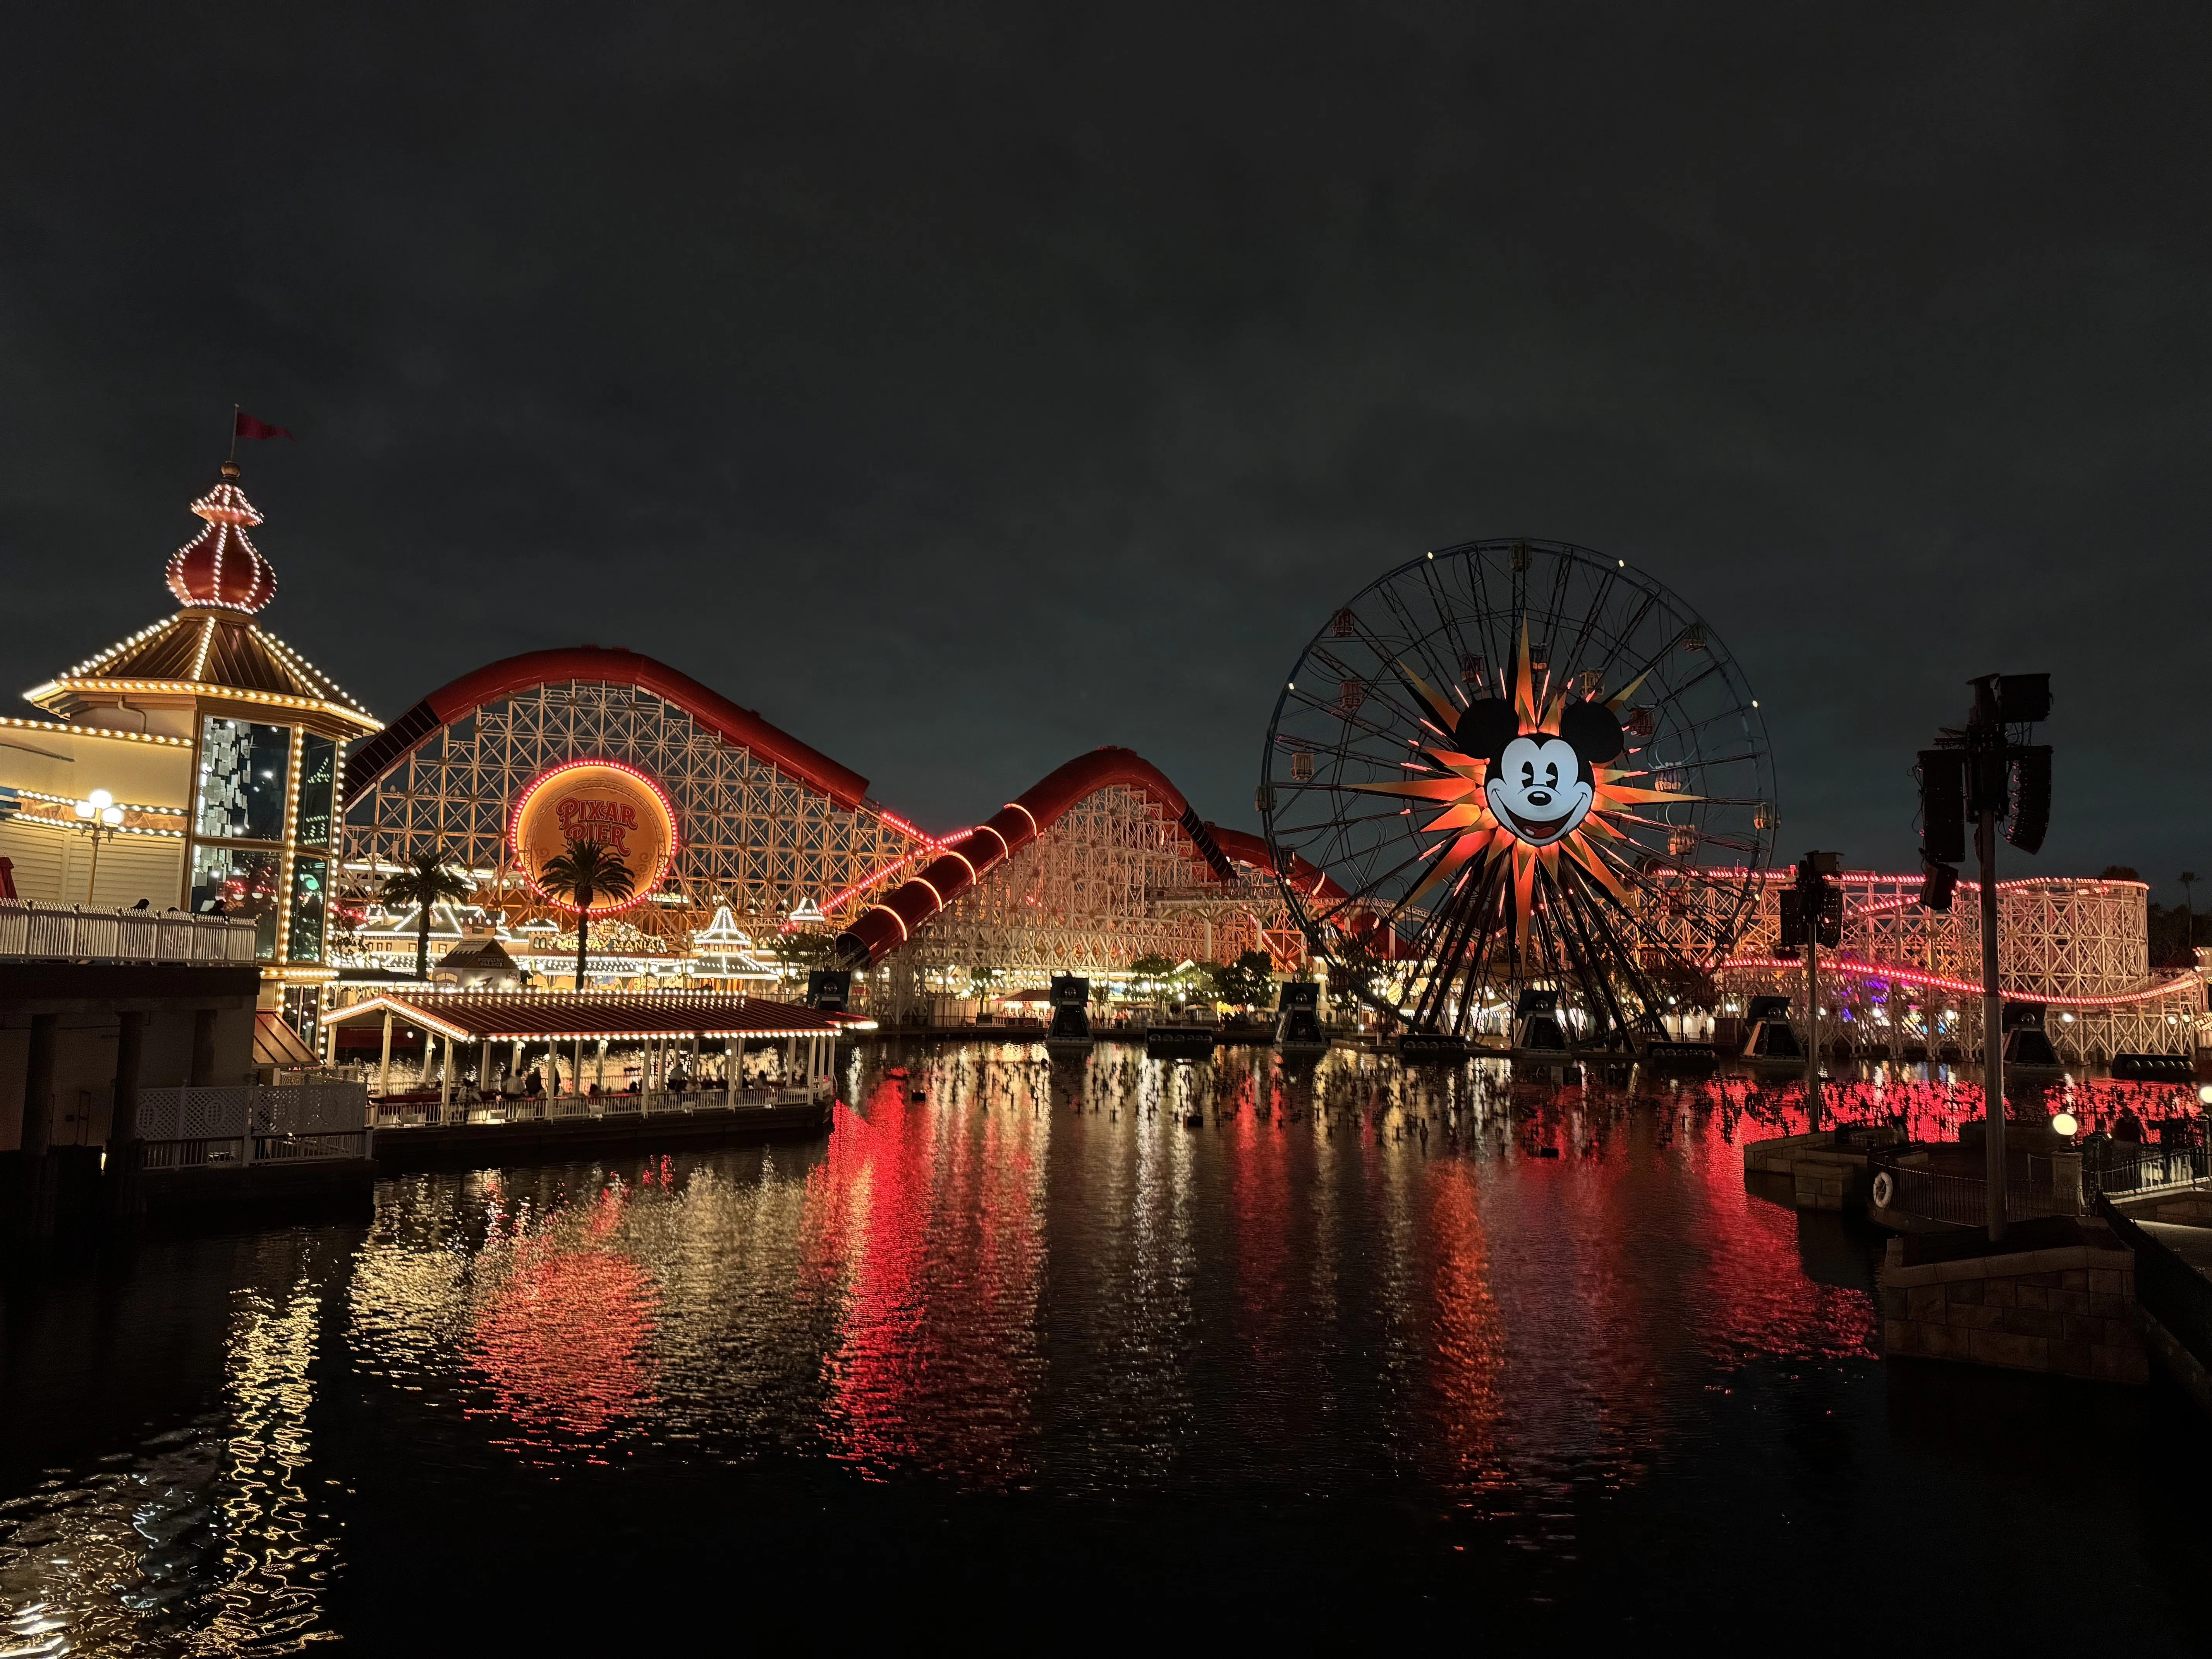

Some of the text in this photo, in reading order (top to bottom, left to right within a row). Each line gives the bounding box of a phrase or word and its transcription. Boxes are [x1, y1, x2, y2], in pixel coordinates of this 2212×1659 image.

[556, 797, 638, 830] PIXAR
[564, 823, 631, 857] PIER
[613, 939, 659, 951] MANIA!
